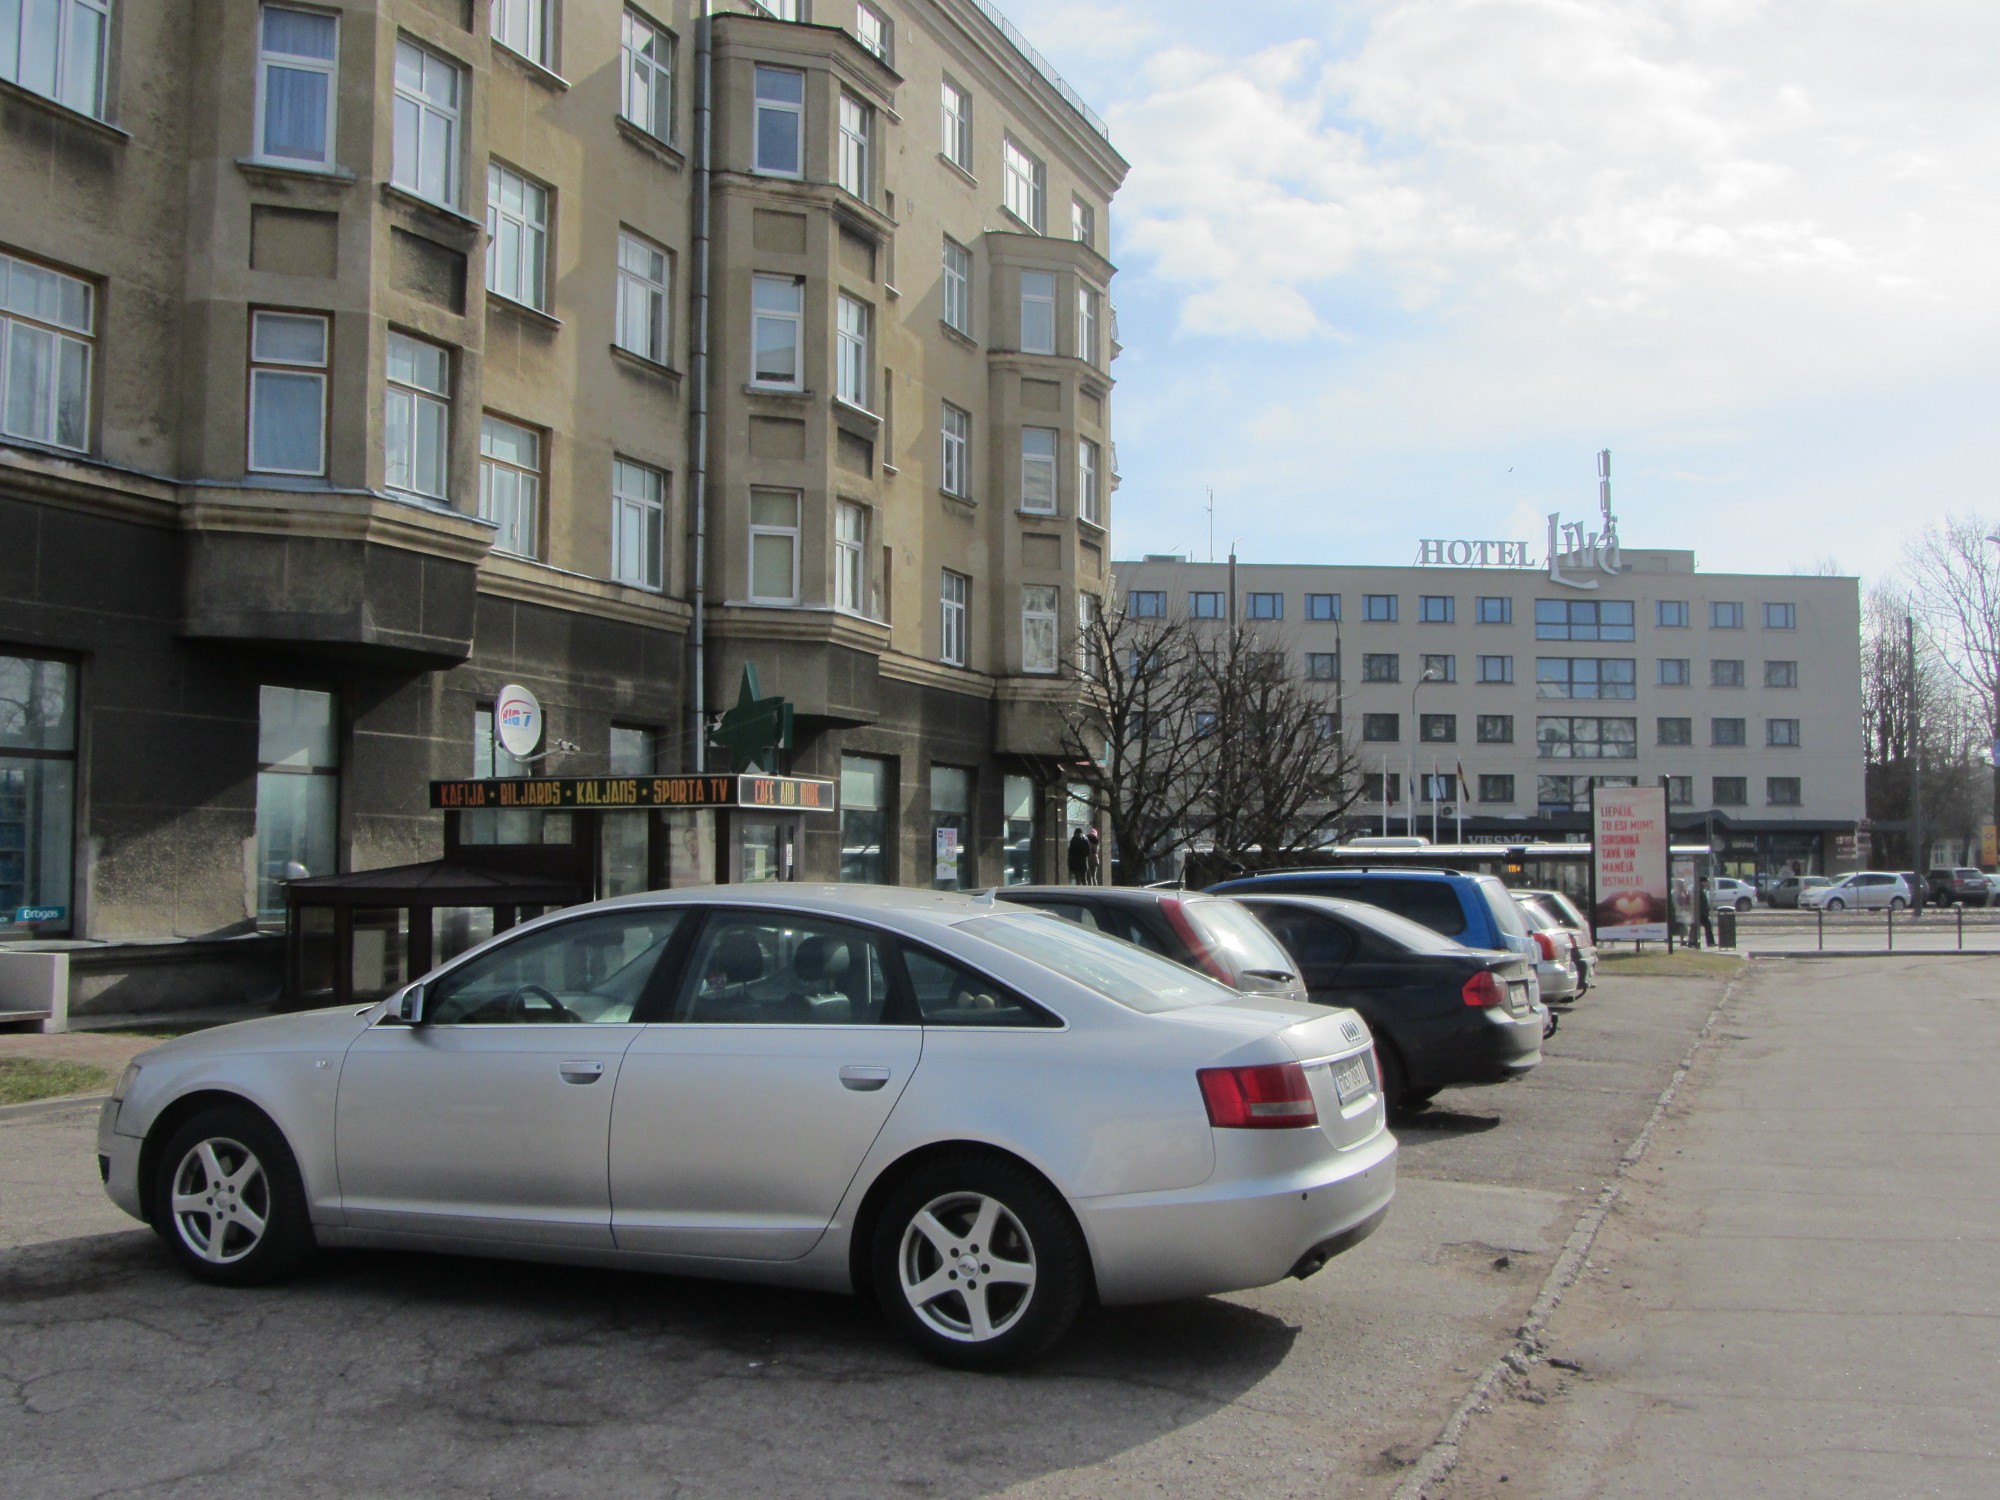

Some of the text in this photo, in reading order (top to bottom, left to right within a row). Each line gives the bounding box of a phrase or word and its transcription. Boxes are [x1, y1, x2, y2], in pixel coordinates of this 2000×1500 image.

[1419, 539, 1535, 566] HOTEL
[522, 711, 532, 728] 7
[440, 779, 728, 806] KAFIJA BILJARDS KALJANS SPORTA TV
[754, 779, 820, 806] CAFE AND MORE
[1601, 820, 1655, 831] TU ESI MUMS
[1624, 848, 1636, 859] UN
[24, 909, 59, 920] Drogas
